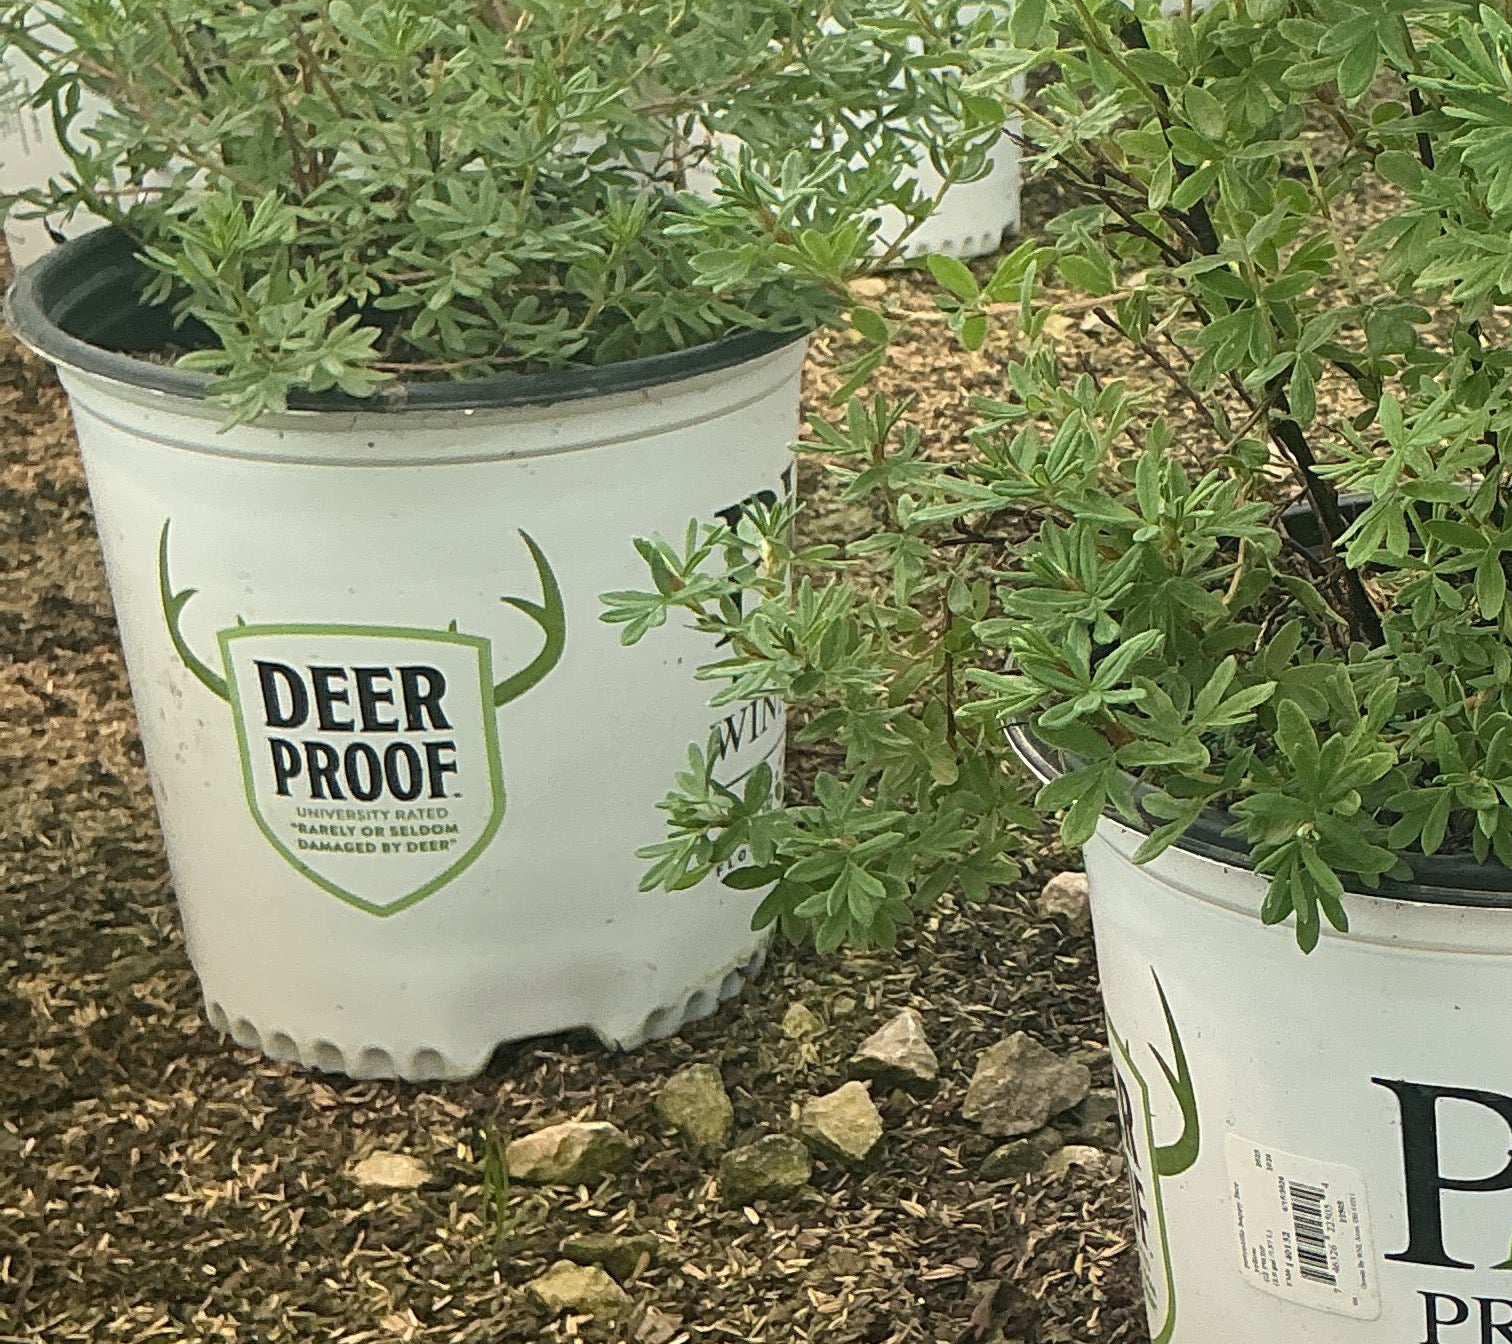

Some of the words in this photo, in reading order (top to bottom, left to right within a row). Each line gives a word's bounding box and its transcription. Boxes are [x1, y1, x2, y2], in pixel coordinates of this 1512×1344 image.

[253, 659, 454, 732] DEER
[267, 736, 459, 802] PROOF
[296, 807, 390, 821] UNIVERSITY
[395, 808, 449, 820] RATED
[362, 824, 384, 837] OR
[390, 824, 459, 836] SELDOM
[297, 838, 376, 853] DAMAGED
[382, 840, 402, 854] BY
